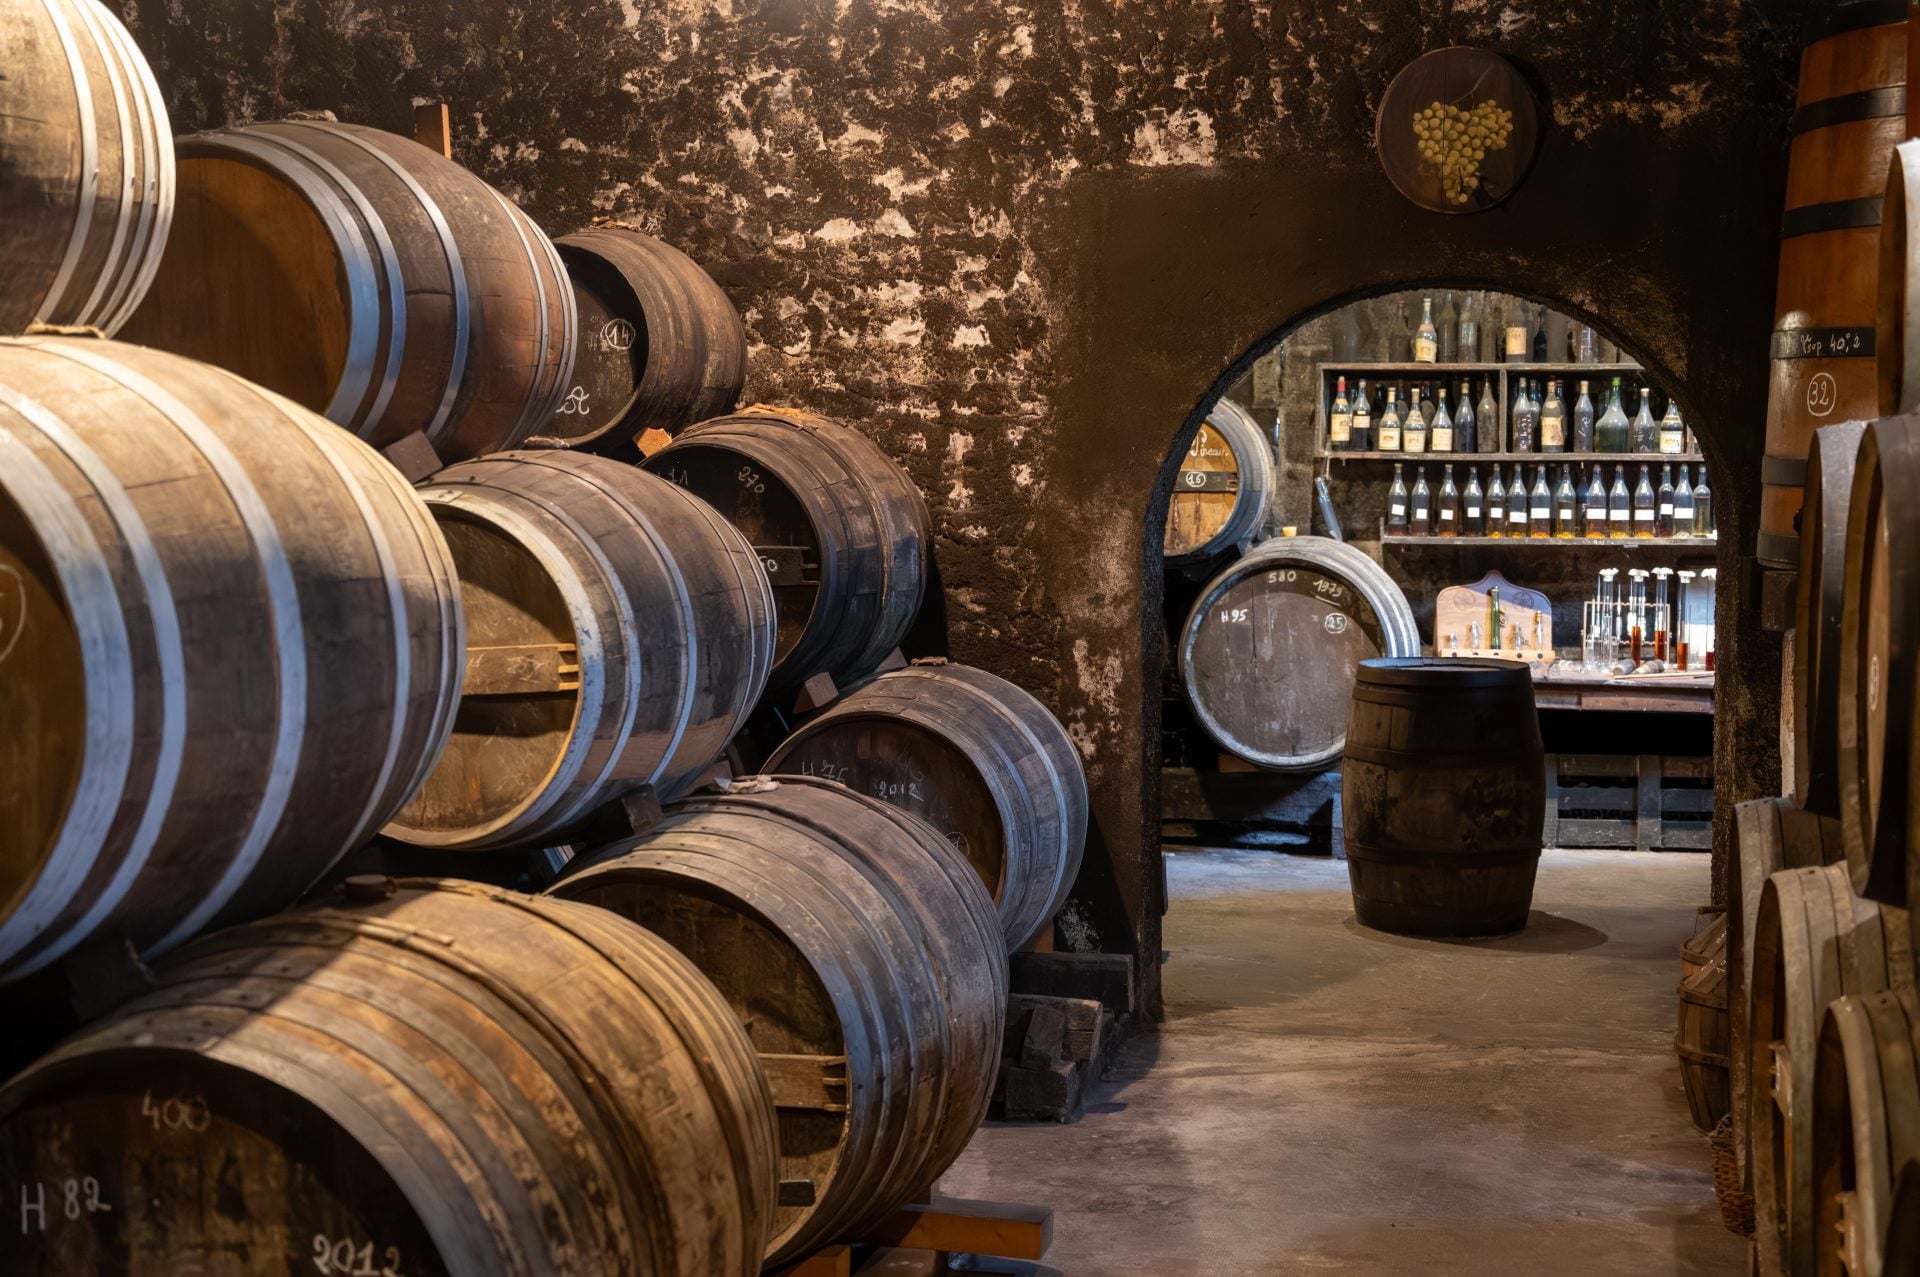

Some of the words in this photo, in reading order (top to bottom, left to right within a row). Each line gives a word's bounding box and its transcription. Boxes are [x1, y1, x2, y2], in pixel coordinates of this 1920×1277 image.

[608, 325, 629, 346] 14
[1809, 381, 1829, 405] 32
[1187, 473, 1201, 484] 16
[1268, 571, 1297, 583] 580
[1220, 610, 1229, 623] H
[1232, 609, 1249, 622] 95
[1327, 616, 1343, 630] 25
[878, 781, 924, 802] 2012
[142, 1090, 210, 1131] 400
[21, 1182, 45, 1234] H
[64, 1176, 111, 1220] 82
